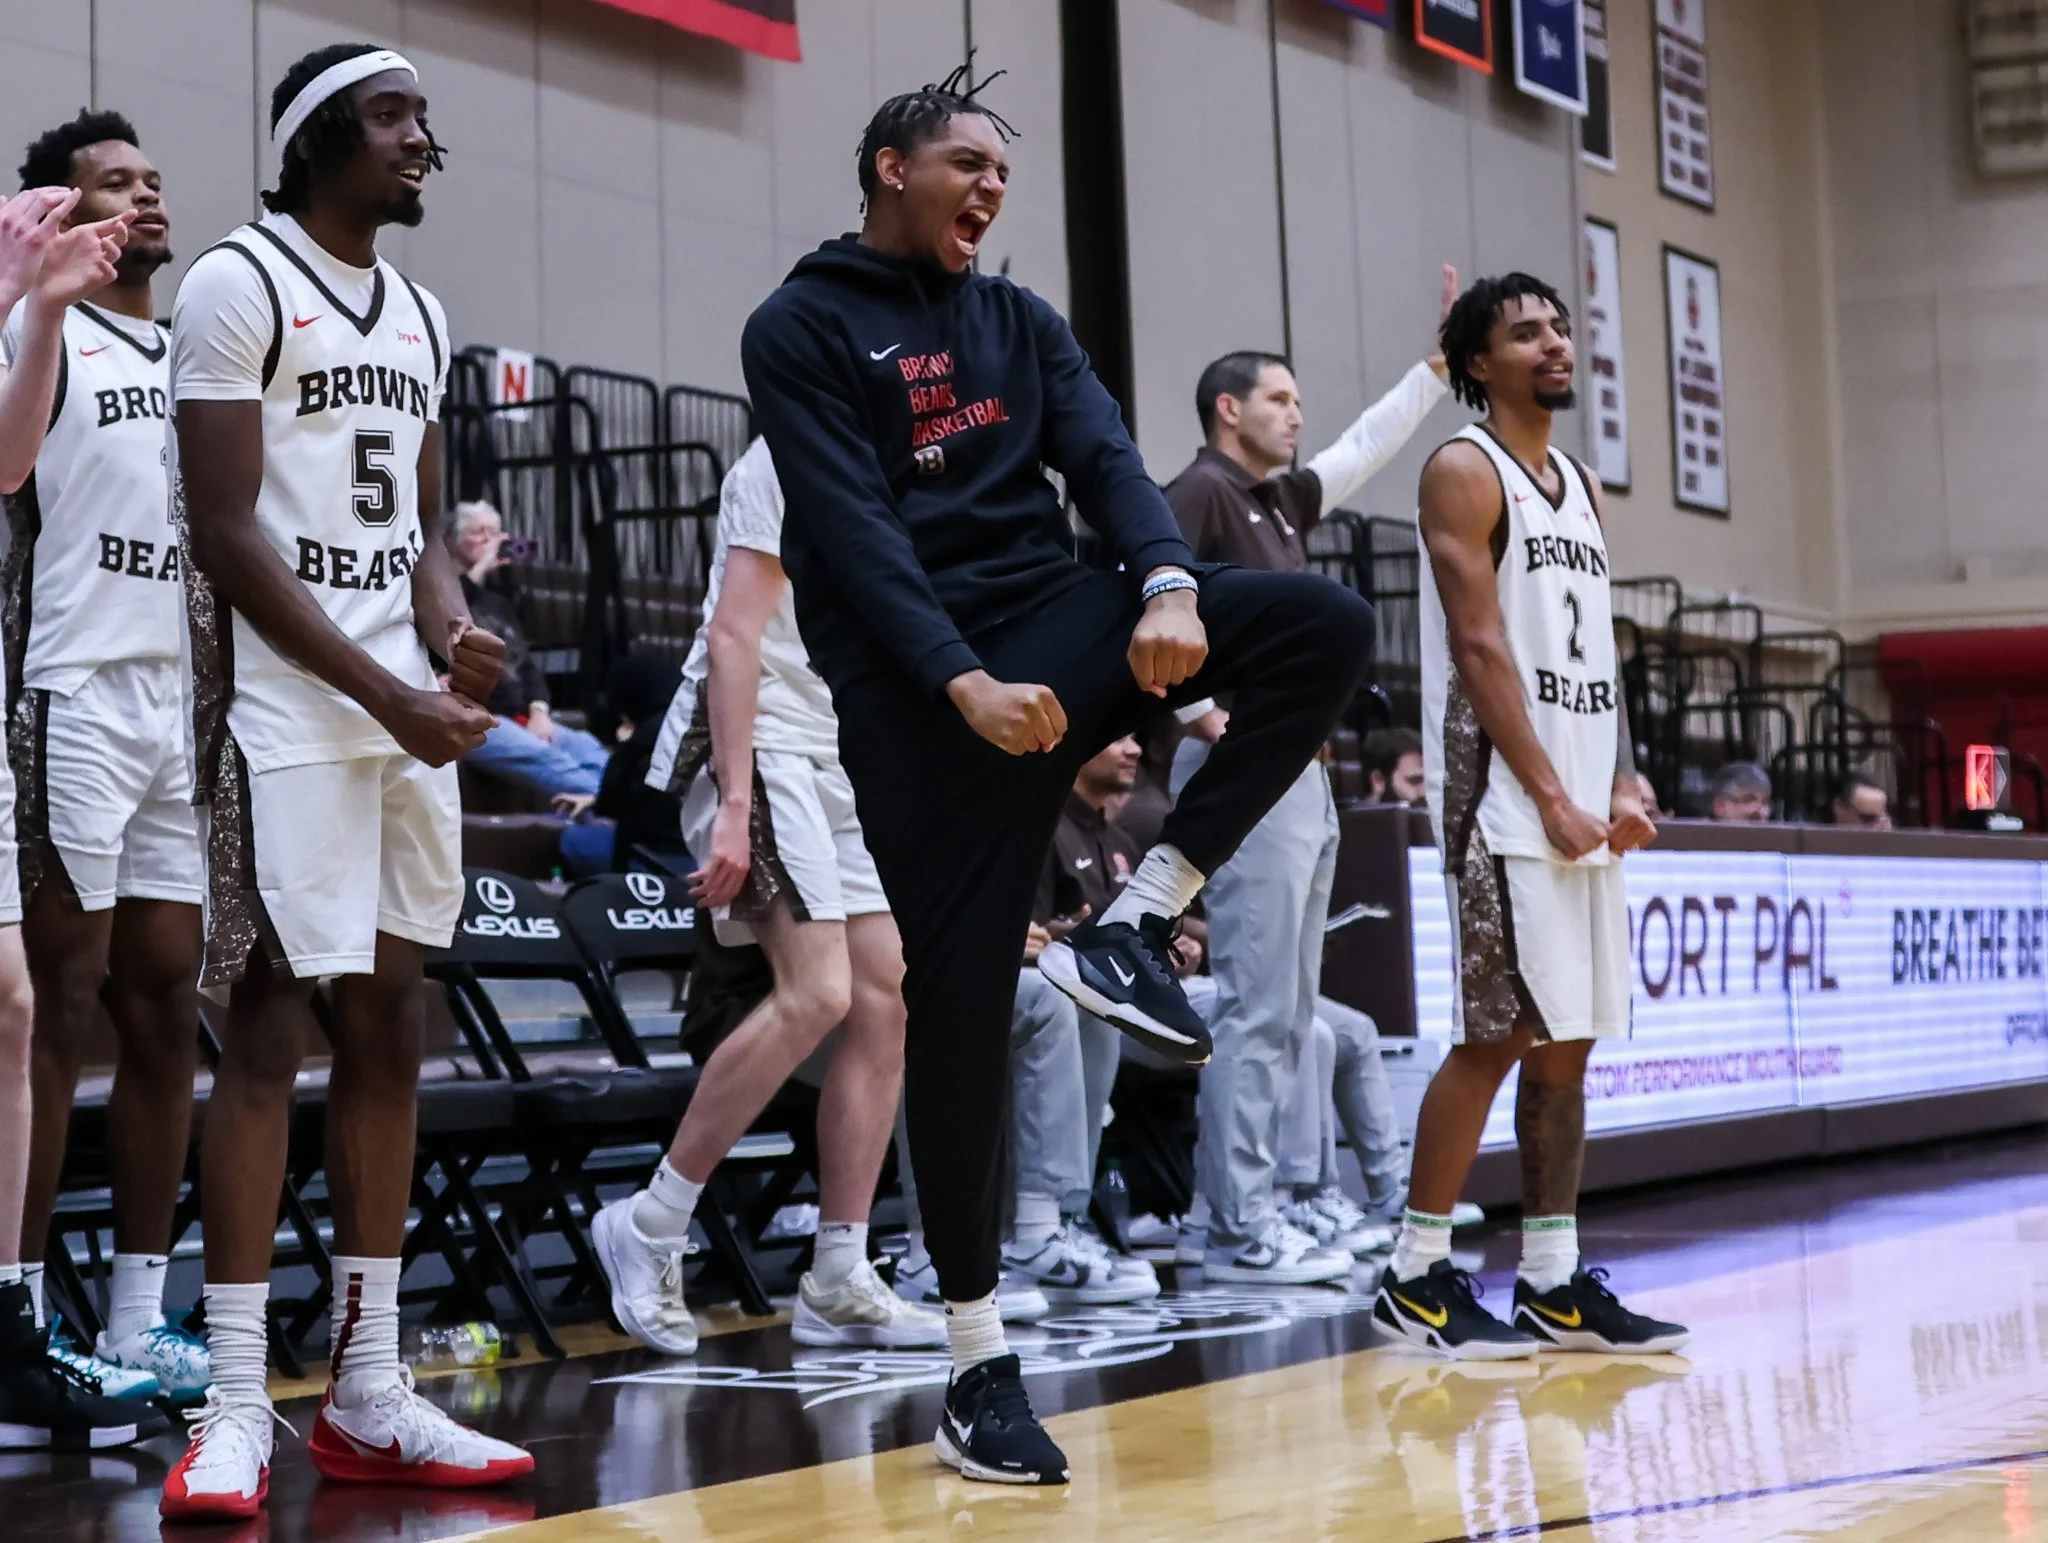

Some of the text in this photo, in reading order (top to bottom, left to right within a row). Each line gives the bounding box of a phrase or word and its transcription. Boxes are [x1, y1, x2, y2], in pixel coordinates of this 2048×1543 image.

[296, 363, 428, 423] BROWN
[503, 362, 526, 404] N
[908, 383, 957, 414] BEARS
[912, 397, 1010, 446] BASKETBALL
[352, 429, 399, 527] 5
[1524, 535, 1608, 577] BROWN
[1563, 586, 1586, 665] 2
[1535, 667, 1618, 714] BEAR
[1628, 895, 1838, 999] ORT PAL
[1893, 907, 2048, 985] BREATHE BE
